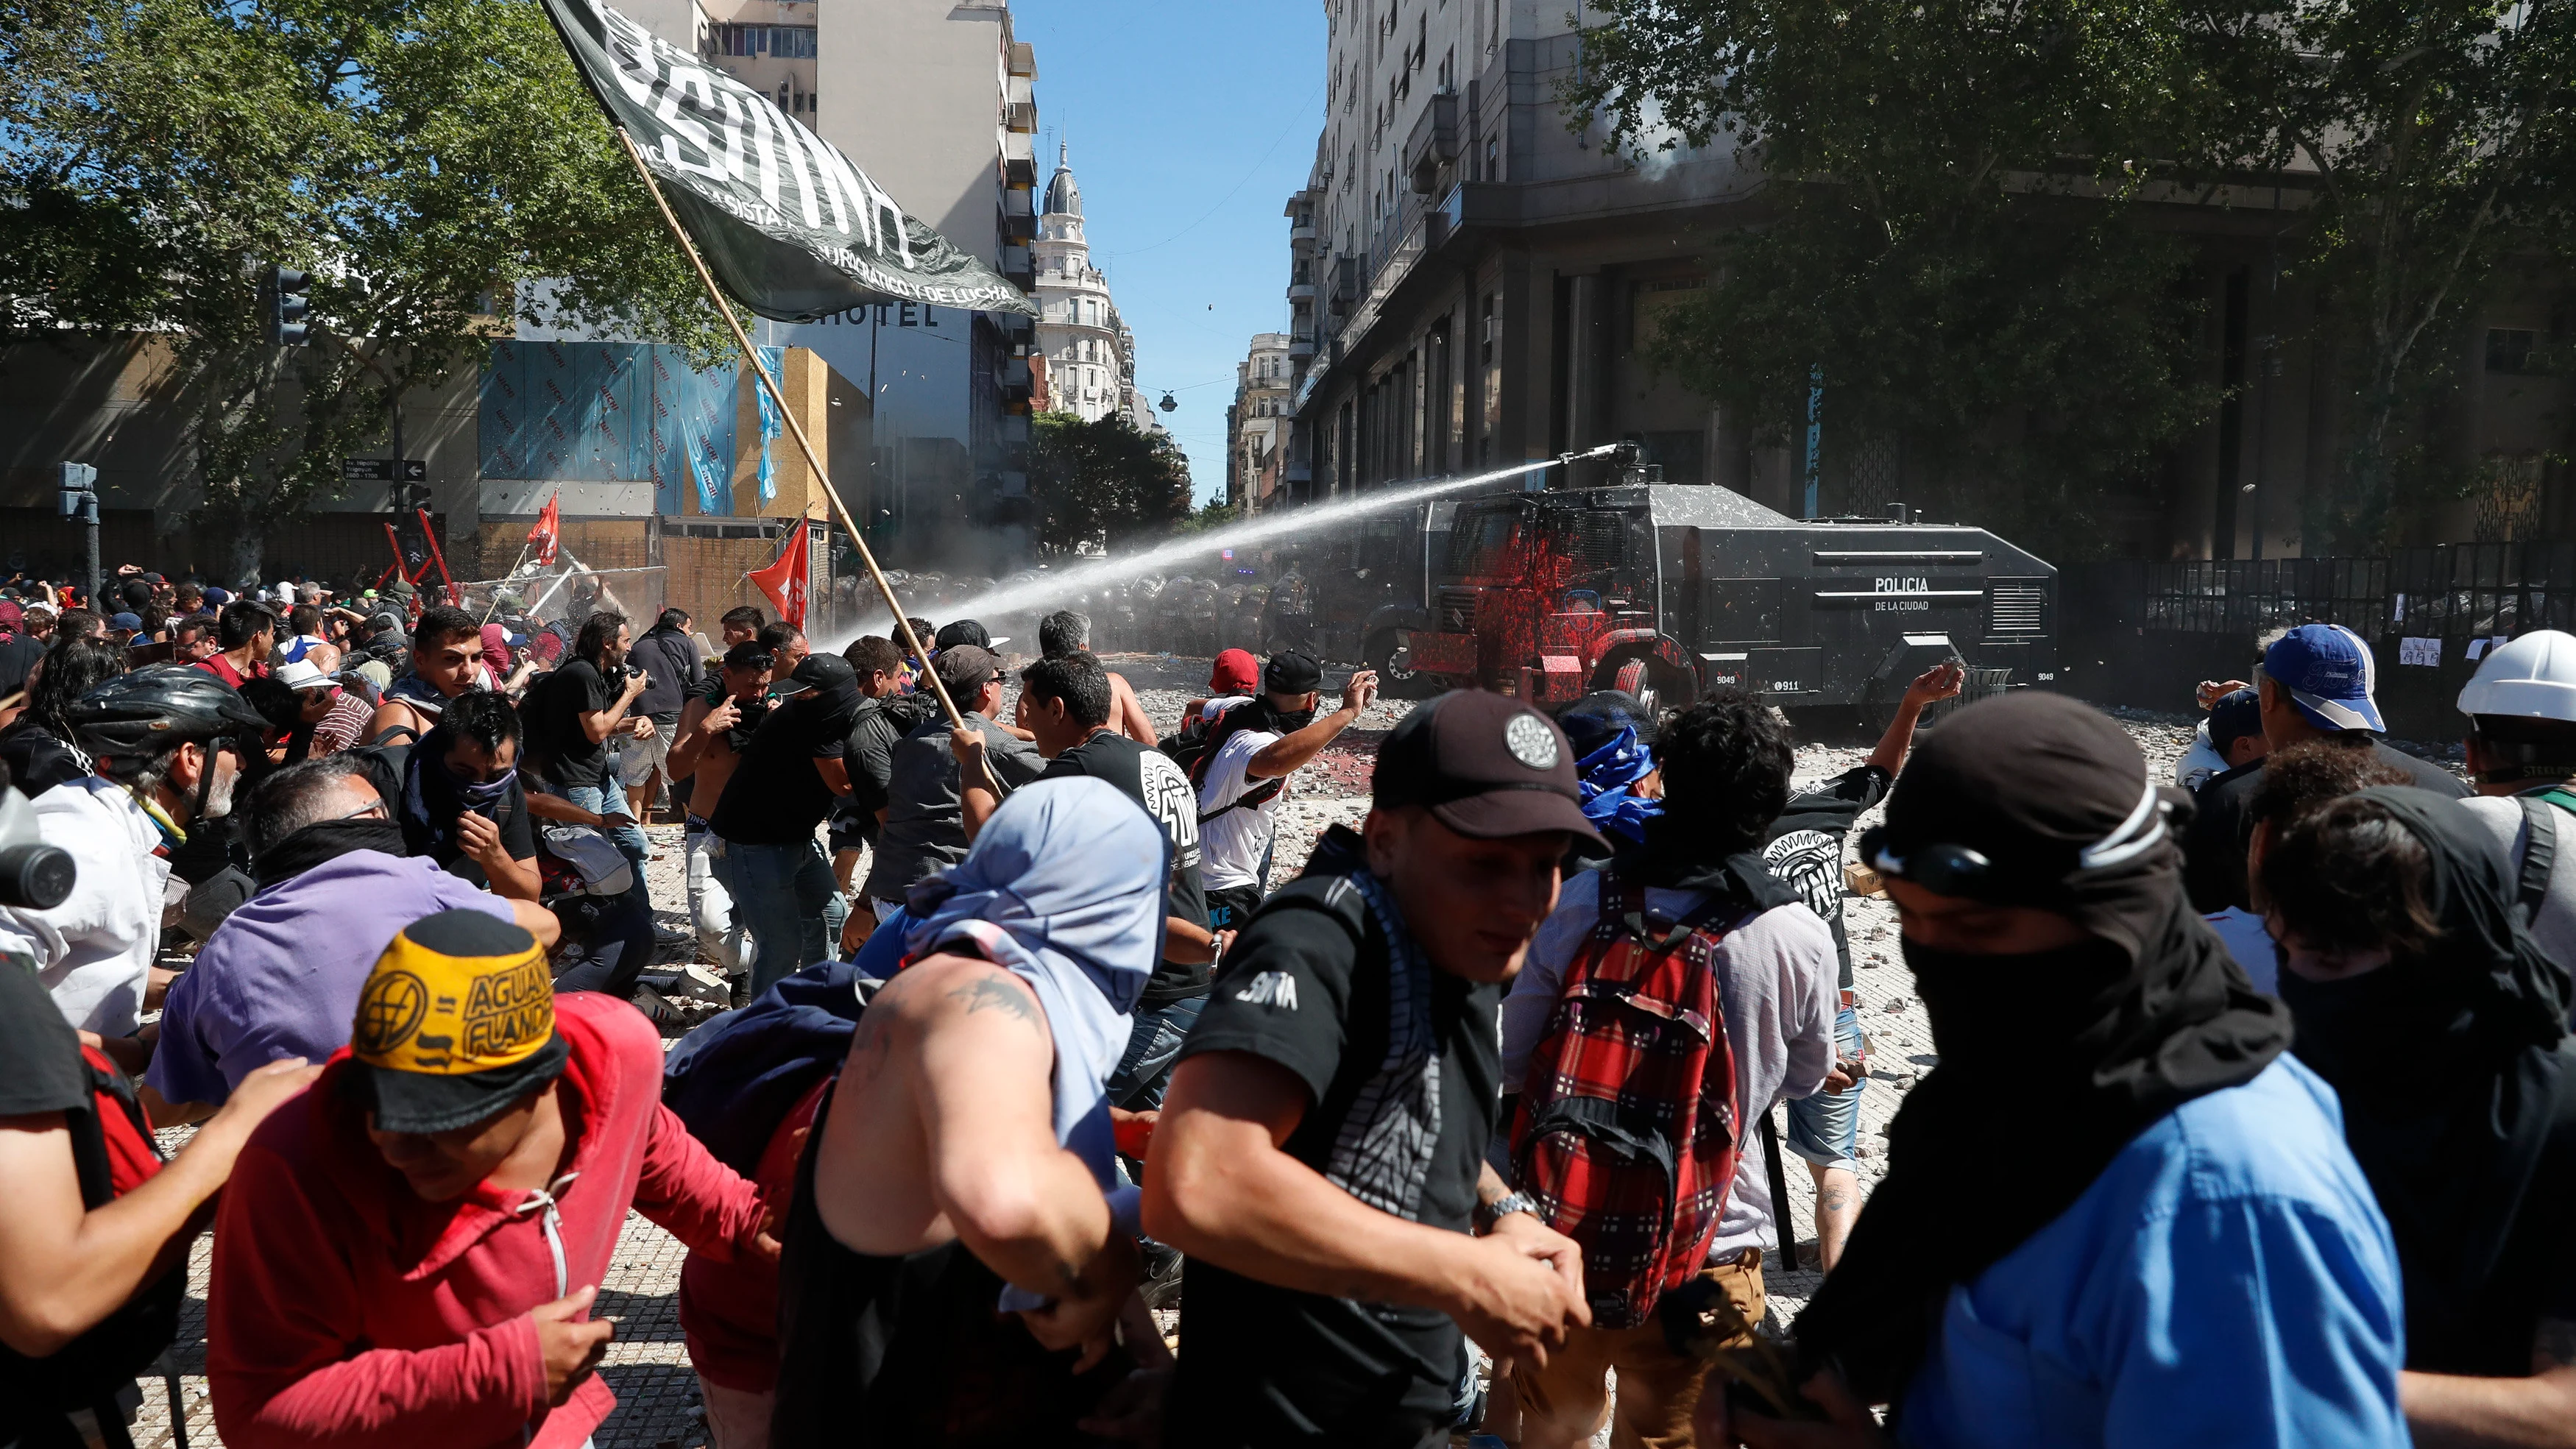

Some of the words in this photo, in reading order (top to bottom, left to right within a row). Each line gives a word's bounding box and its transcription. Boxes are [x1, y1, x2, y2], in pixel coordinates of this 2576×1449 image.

[924, 285, 954, 303] DE
[952, 284, 1014, 303] LUCHA
[1875, 577, 1929, 592] POLICIA
[1875, 602, 1886, 611] DE
[1888, 601, 1898, 611] LA
[1899, 600, 1929, 611] CIUDAD
[1716, 676, 1735, 684] 9049
[1783, 681, 1799, 690] 911
[2037, 672, 2054, 681] 9049
[1209, 906, 1231, 927] KE
